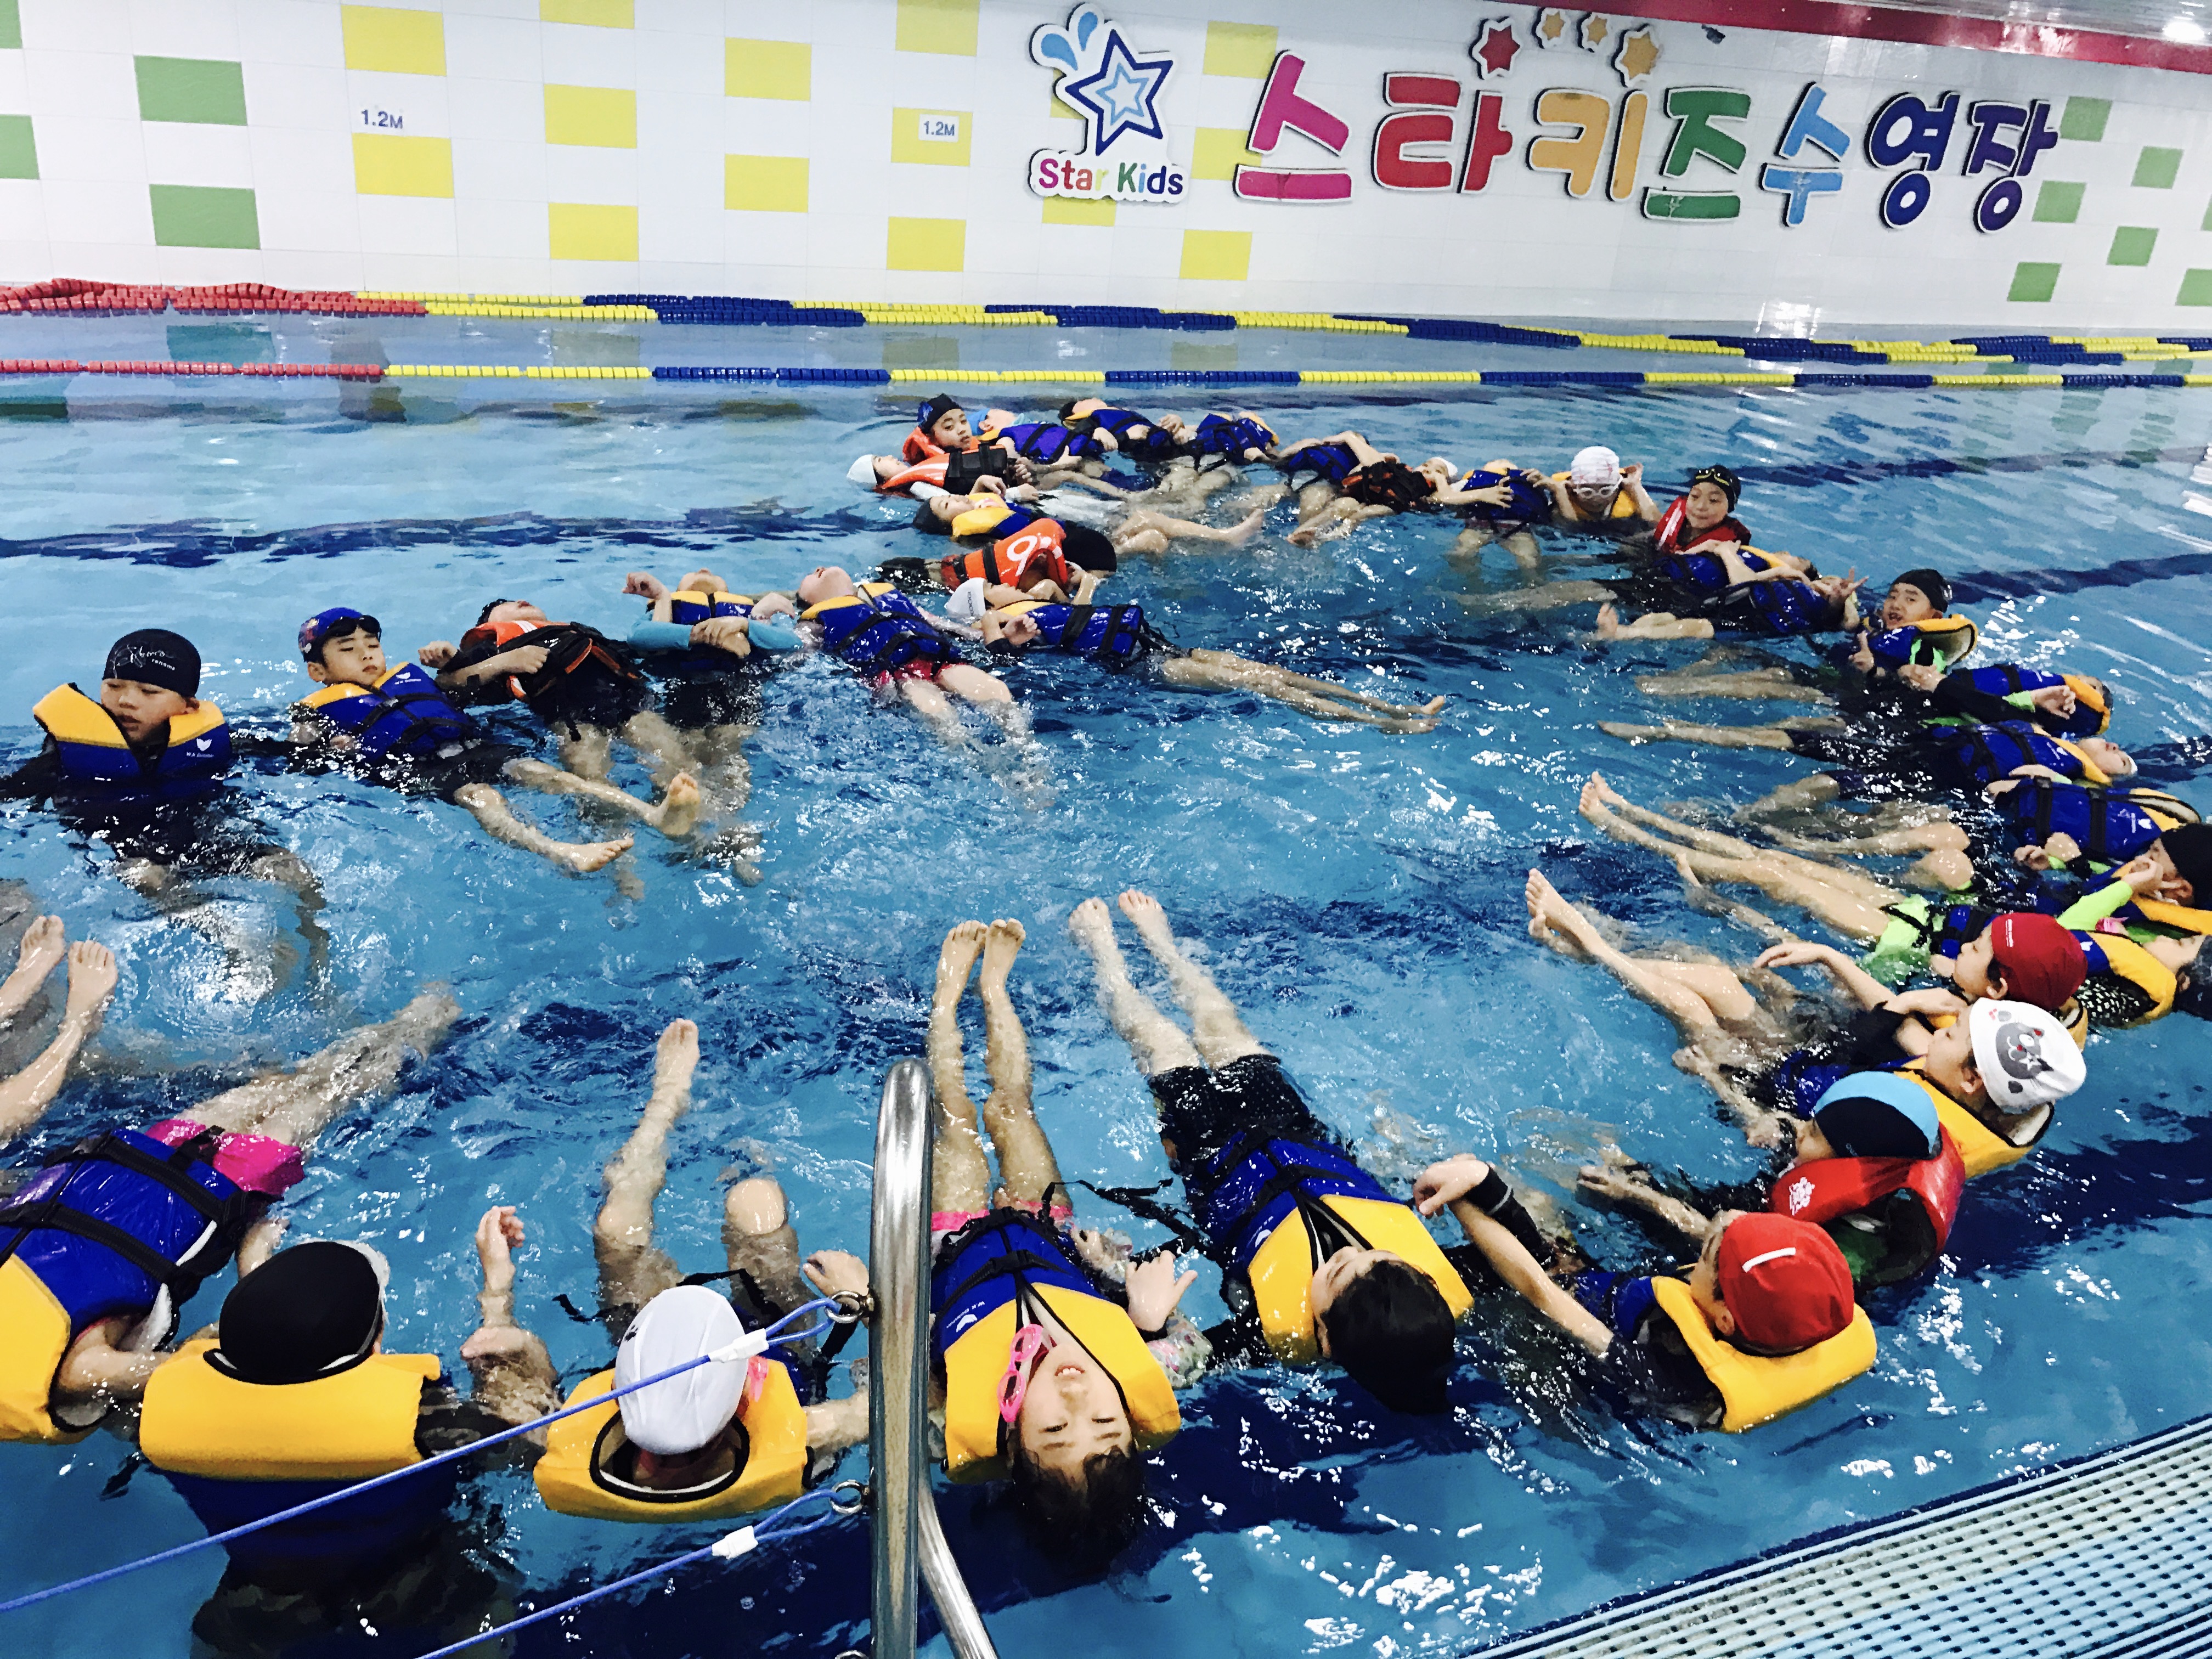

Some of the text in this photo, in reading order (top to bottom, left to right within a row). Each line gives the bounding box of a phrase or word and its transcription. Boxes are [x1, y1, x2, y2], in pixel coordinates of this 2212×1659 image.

[360, 109, 403, 129] 1.2M
[923, 120, 955, 136] 1.2M
[1039, 158, 1183, 195] Star Kids
